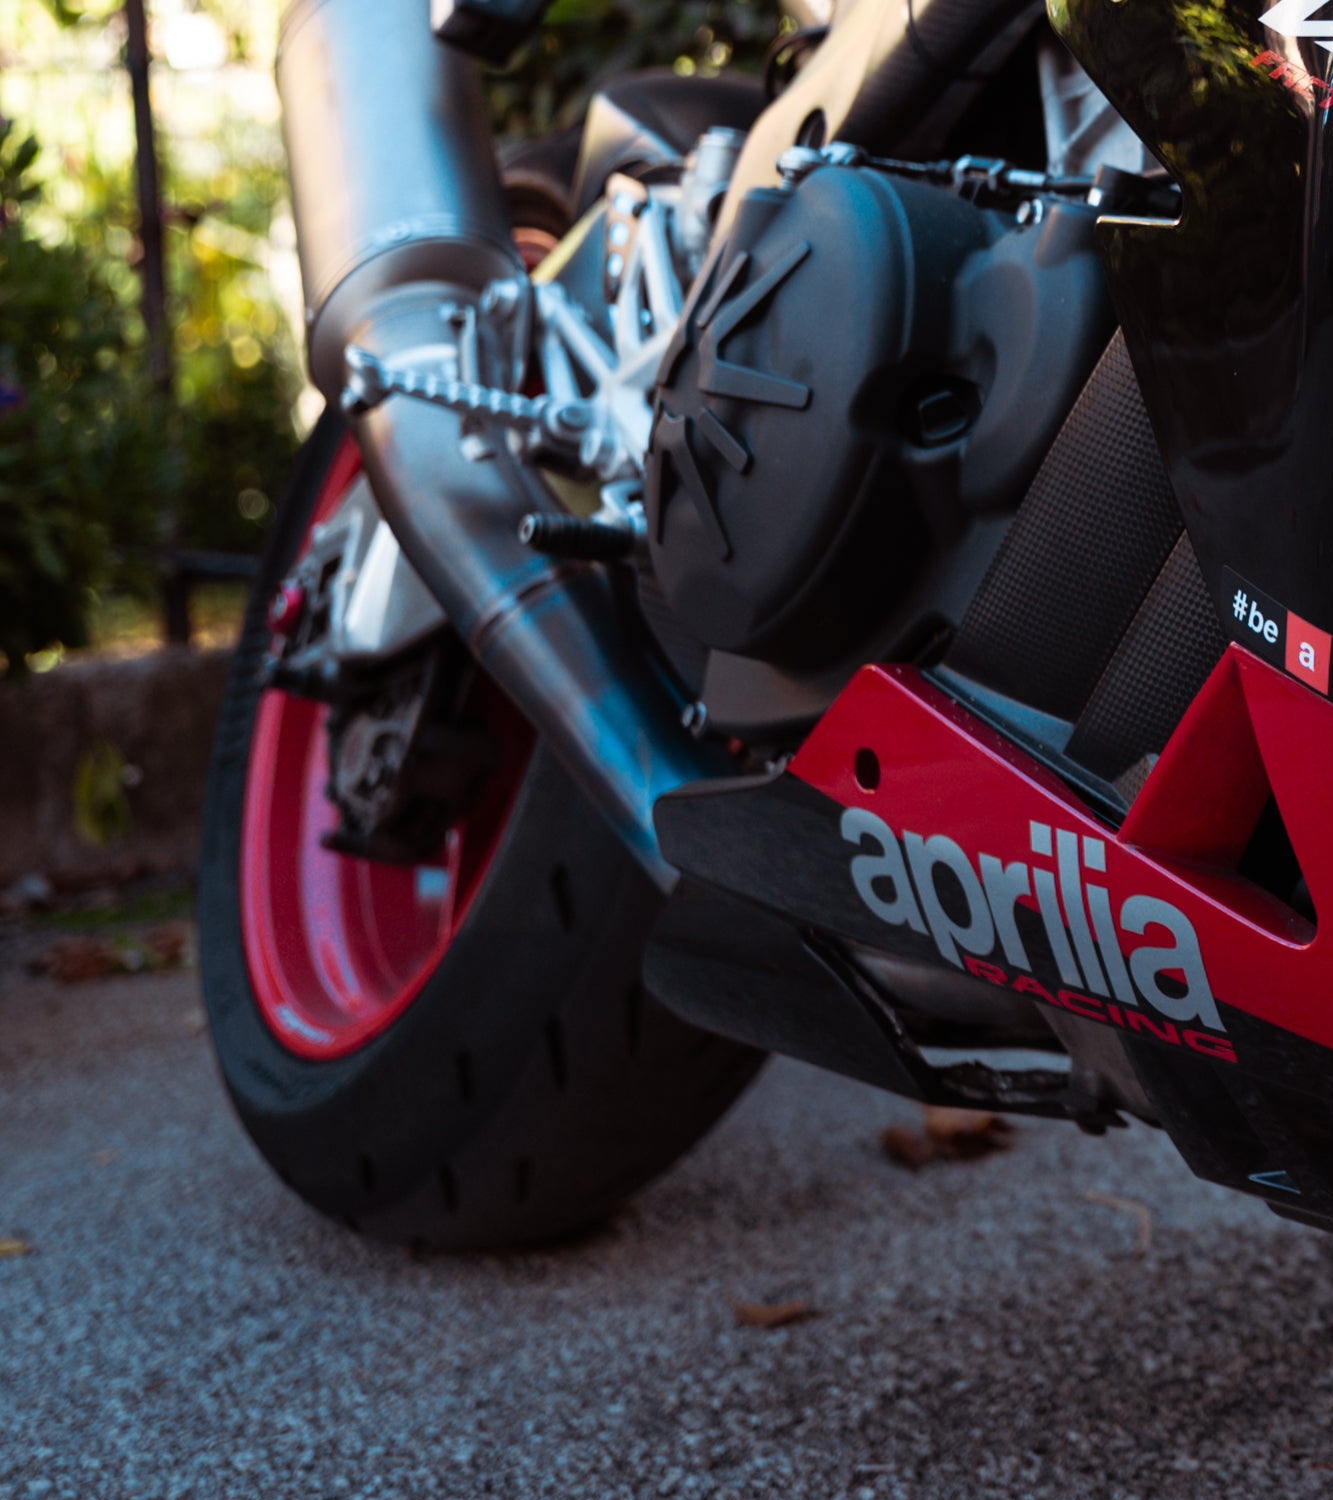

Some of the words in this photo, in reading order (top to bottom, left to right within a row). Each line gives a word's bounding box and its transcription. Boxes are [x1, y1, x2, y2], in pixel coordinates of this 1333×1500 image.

[1232, 589, 1279, 643] #be
[1298, 640, 1316, 672] a
[840, 806, 1228, 1033] aprilia
[963, 954, 1239, 1064] RACING
